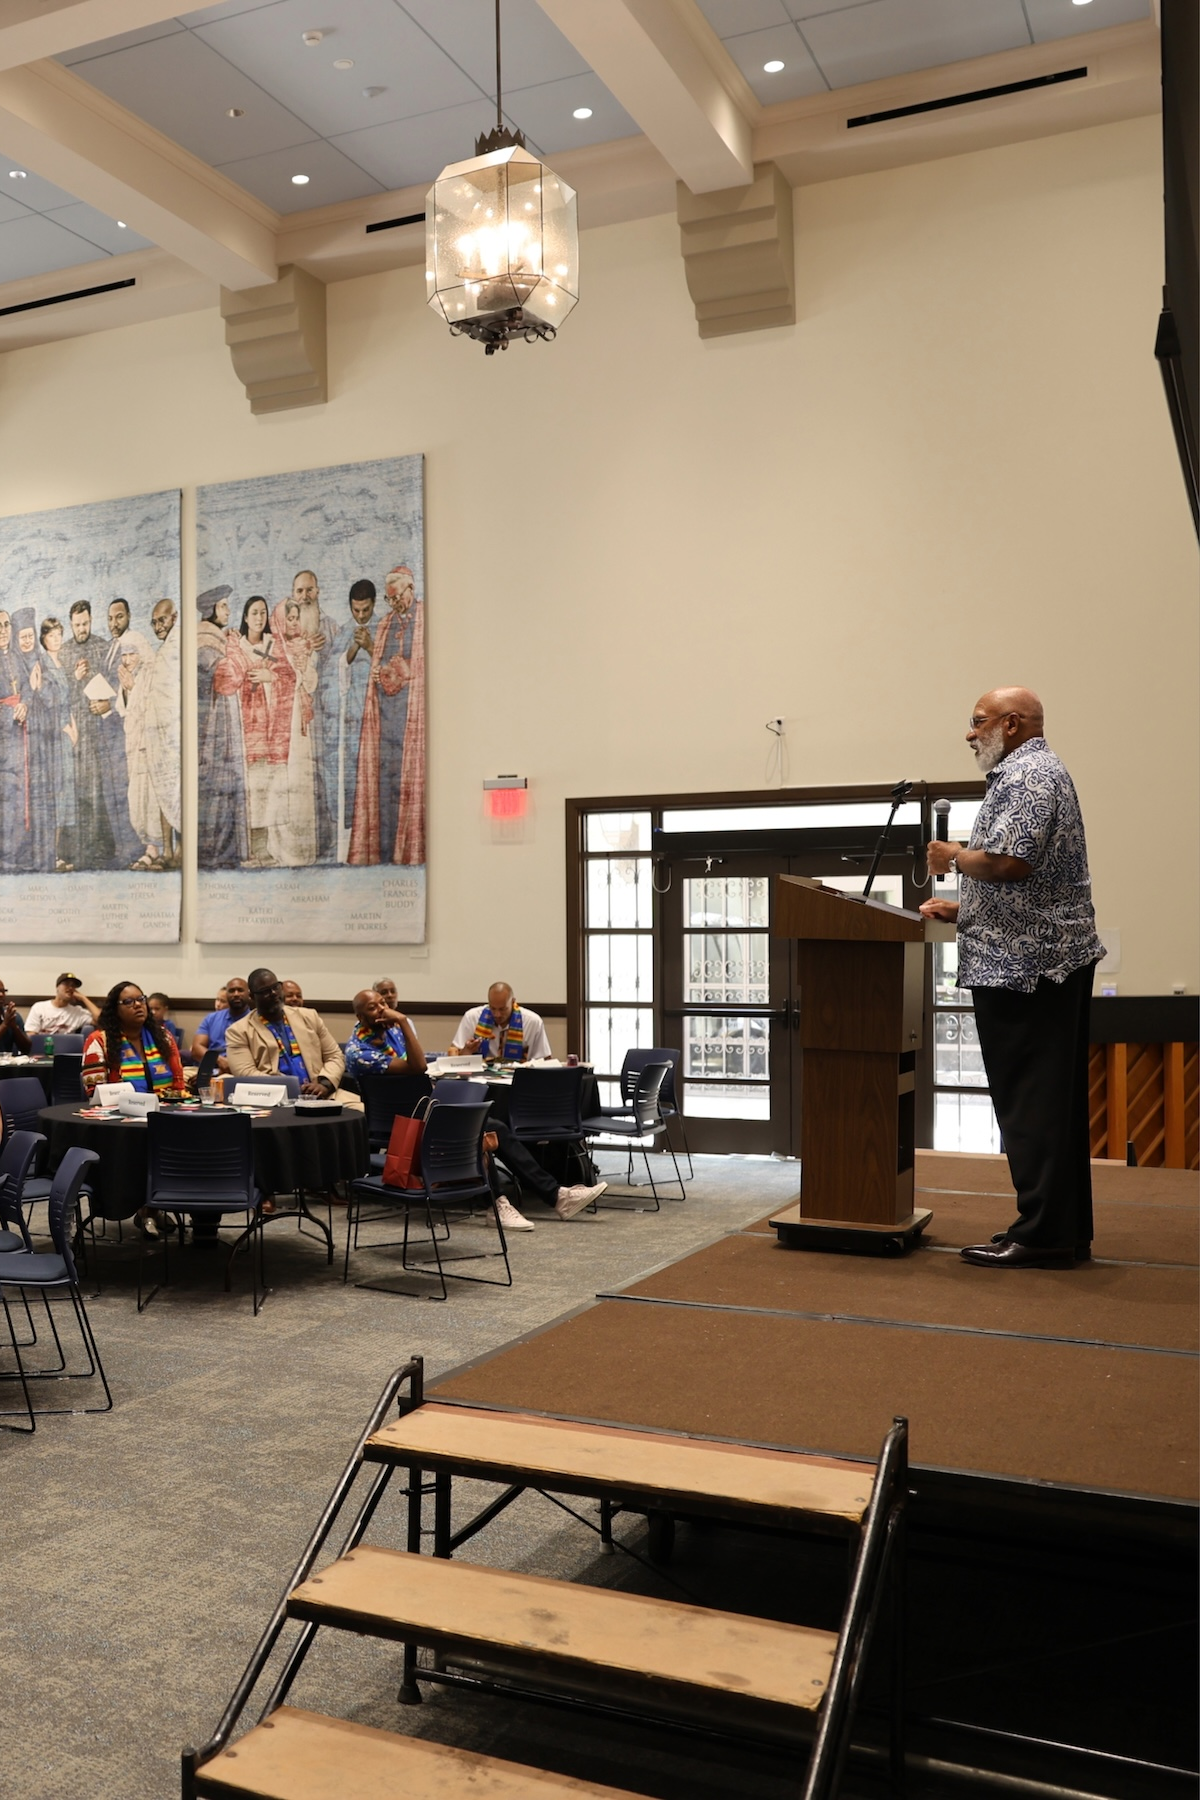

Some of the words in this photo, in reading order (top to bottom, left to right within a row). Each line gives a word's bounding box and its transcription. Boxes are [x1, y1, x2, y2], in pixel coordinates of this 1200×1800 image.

[128, 882, 158, 890] MOTHER
[204, 882, 236, 891] THOMAS
[275, 883, 300, 891] SARAH
[382, 879, 419, 888] CHARLES
[130, 892, 155, 900] TERESA
[209, 892, 230, 900] MORE
[383, 889, 418, 899] FRANCIS
[291, 895, 330, 903] ABRAHAM
[101, 903, 129, 911] MARTIN
[385, 900, 415, 909] BUDDY
[101, 912, 129, 921] LUTHER
[139, 911, 175, 919] MAHATMA
[350, 911, 382, 920] MARTIN
[106, 922, 124, 930] KING
[344, 922, 356, 931] DE
[247, 1090, 271, 1098] Reserved
[127, 1099, 146, 1107] Reserved
